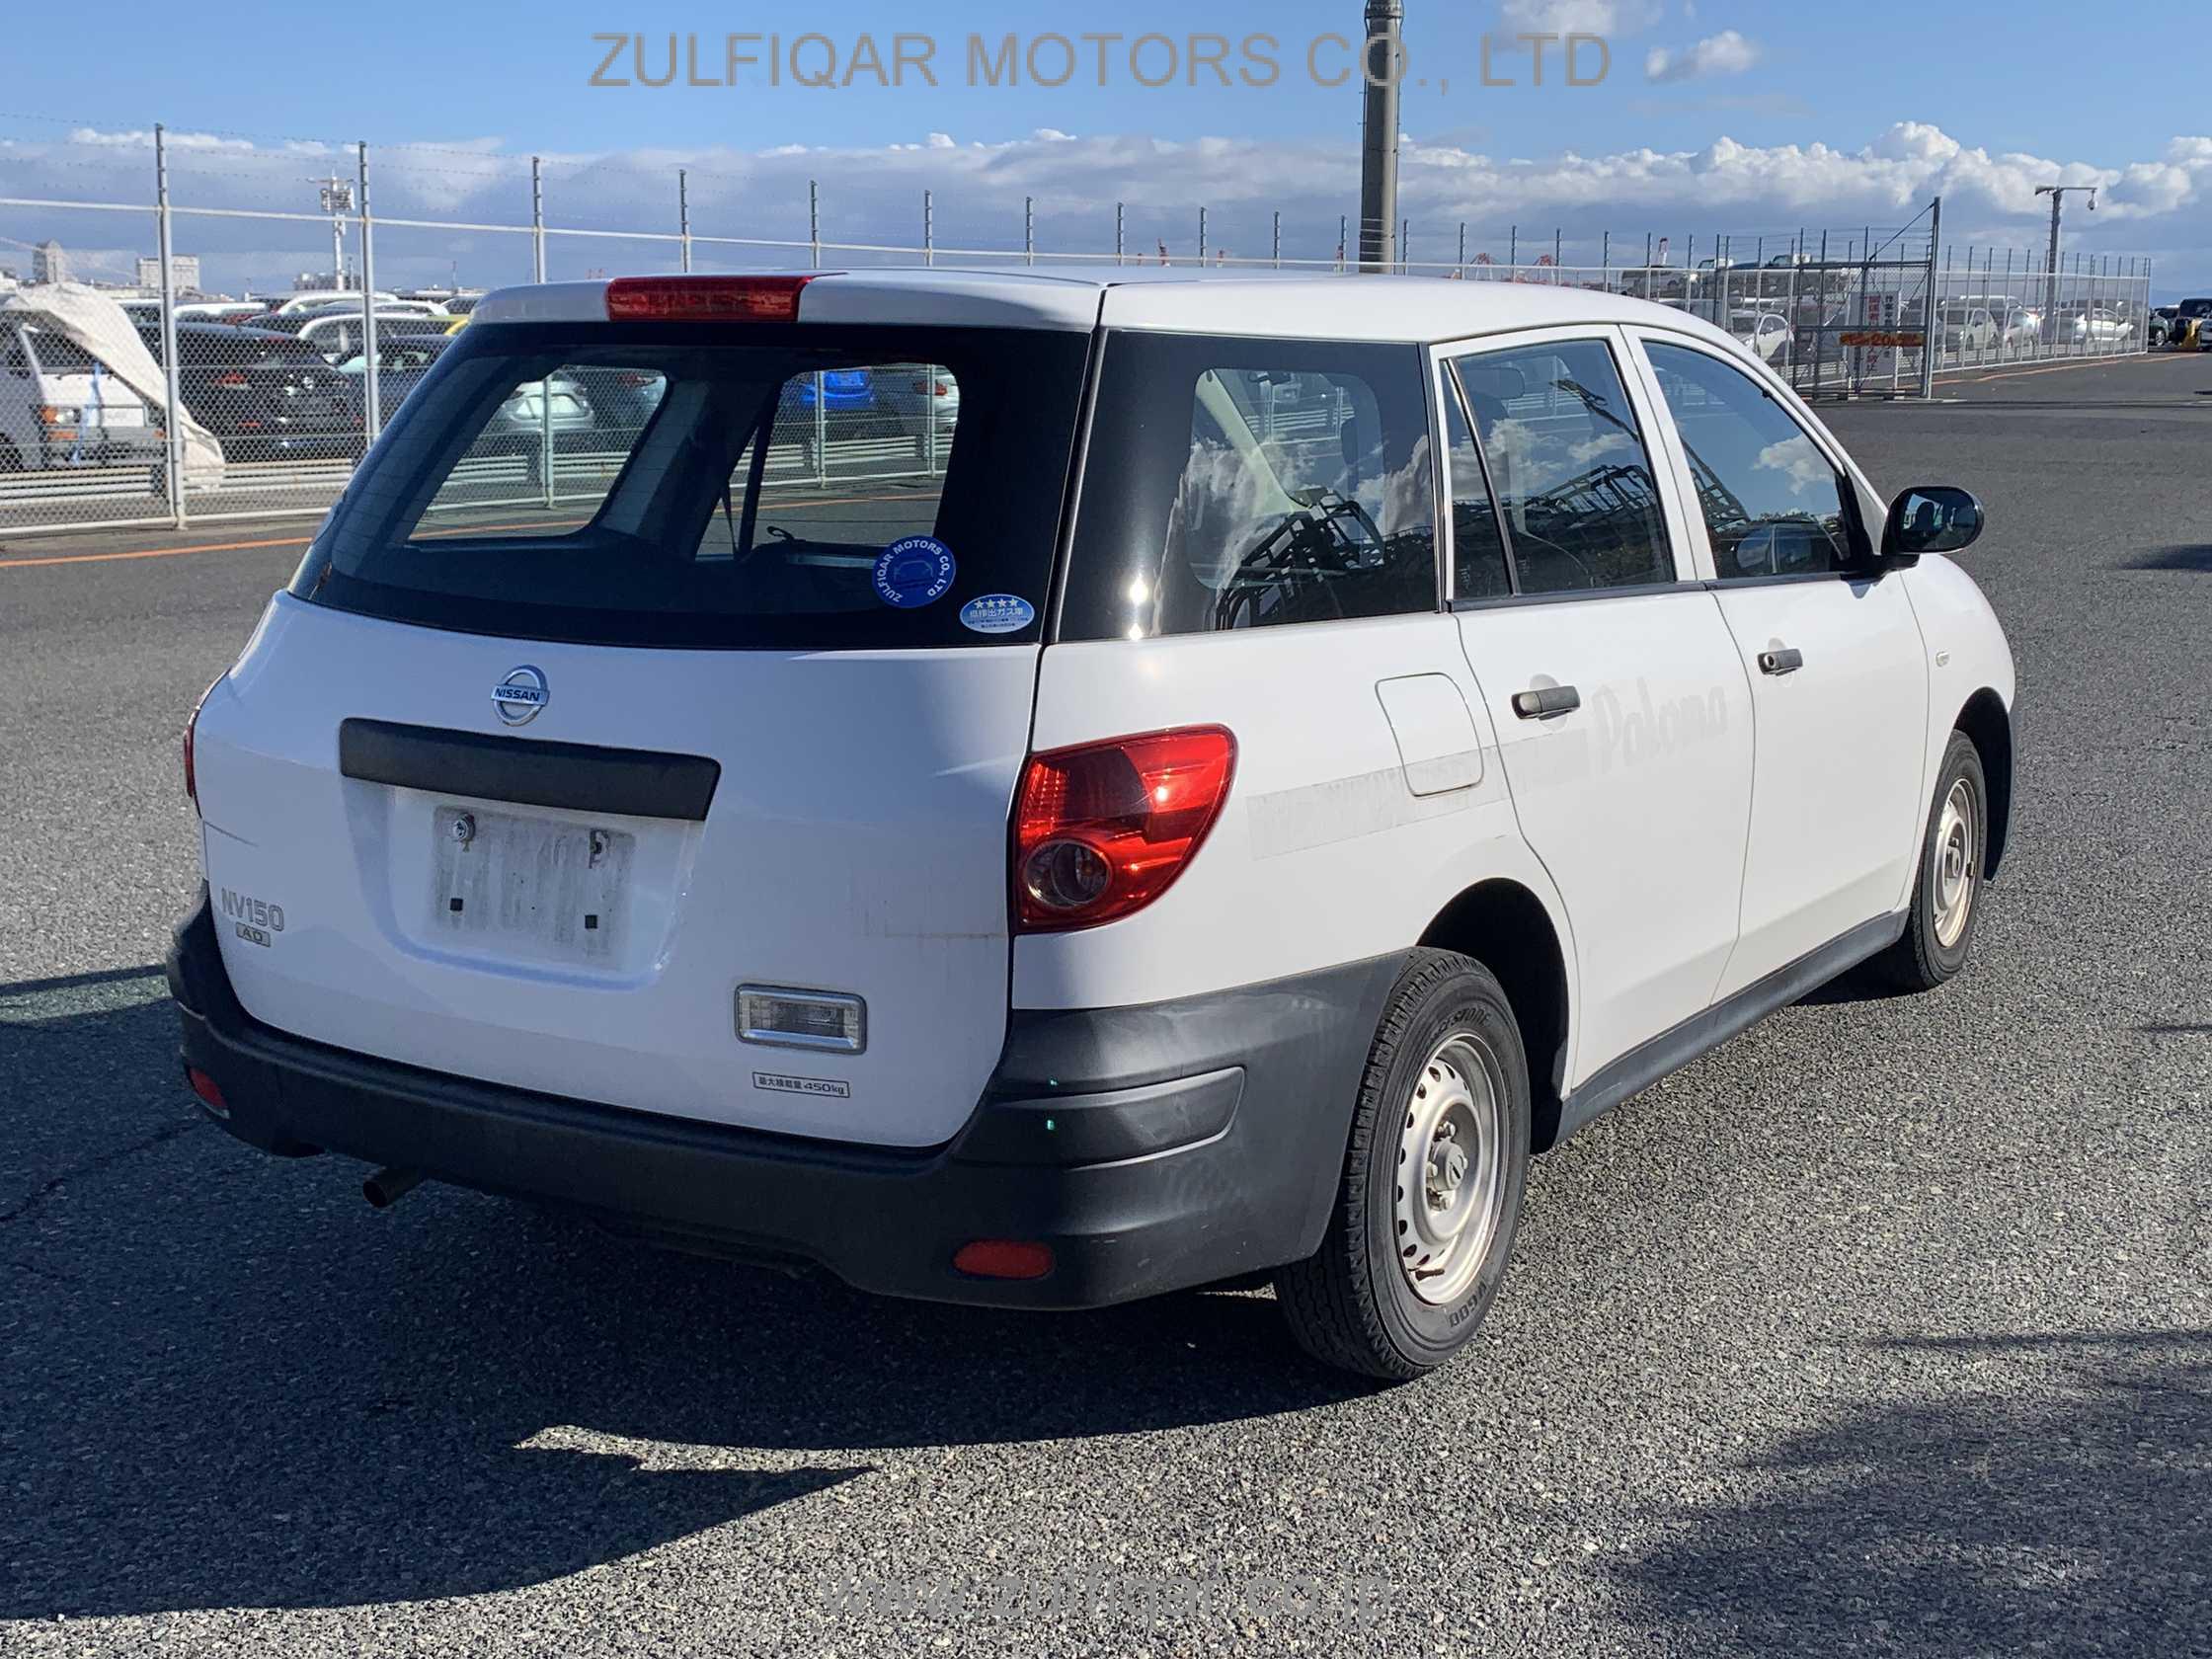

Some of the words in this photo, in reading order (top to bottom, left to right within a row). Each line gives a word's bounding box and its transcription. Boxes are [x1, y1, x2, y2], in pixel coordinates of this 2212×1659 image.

[892, 539, 944, 556] MOTORS
[926, 578, 947, 597] LTD
[494, 687, 541, 702] NISSAN
[220, 886, 285, 932] NV150
[243, 926, 264, 942] AD
